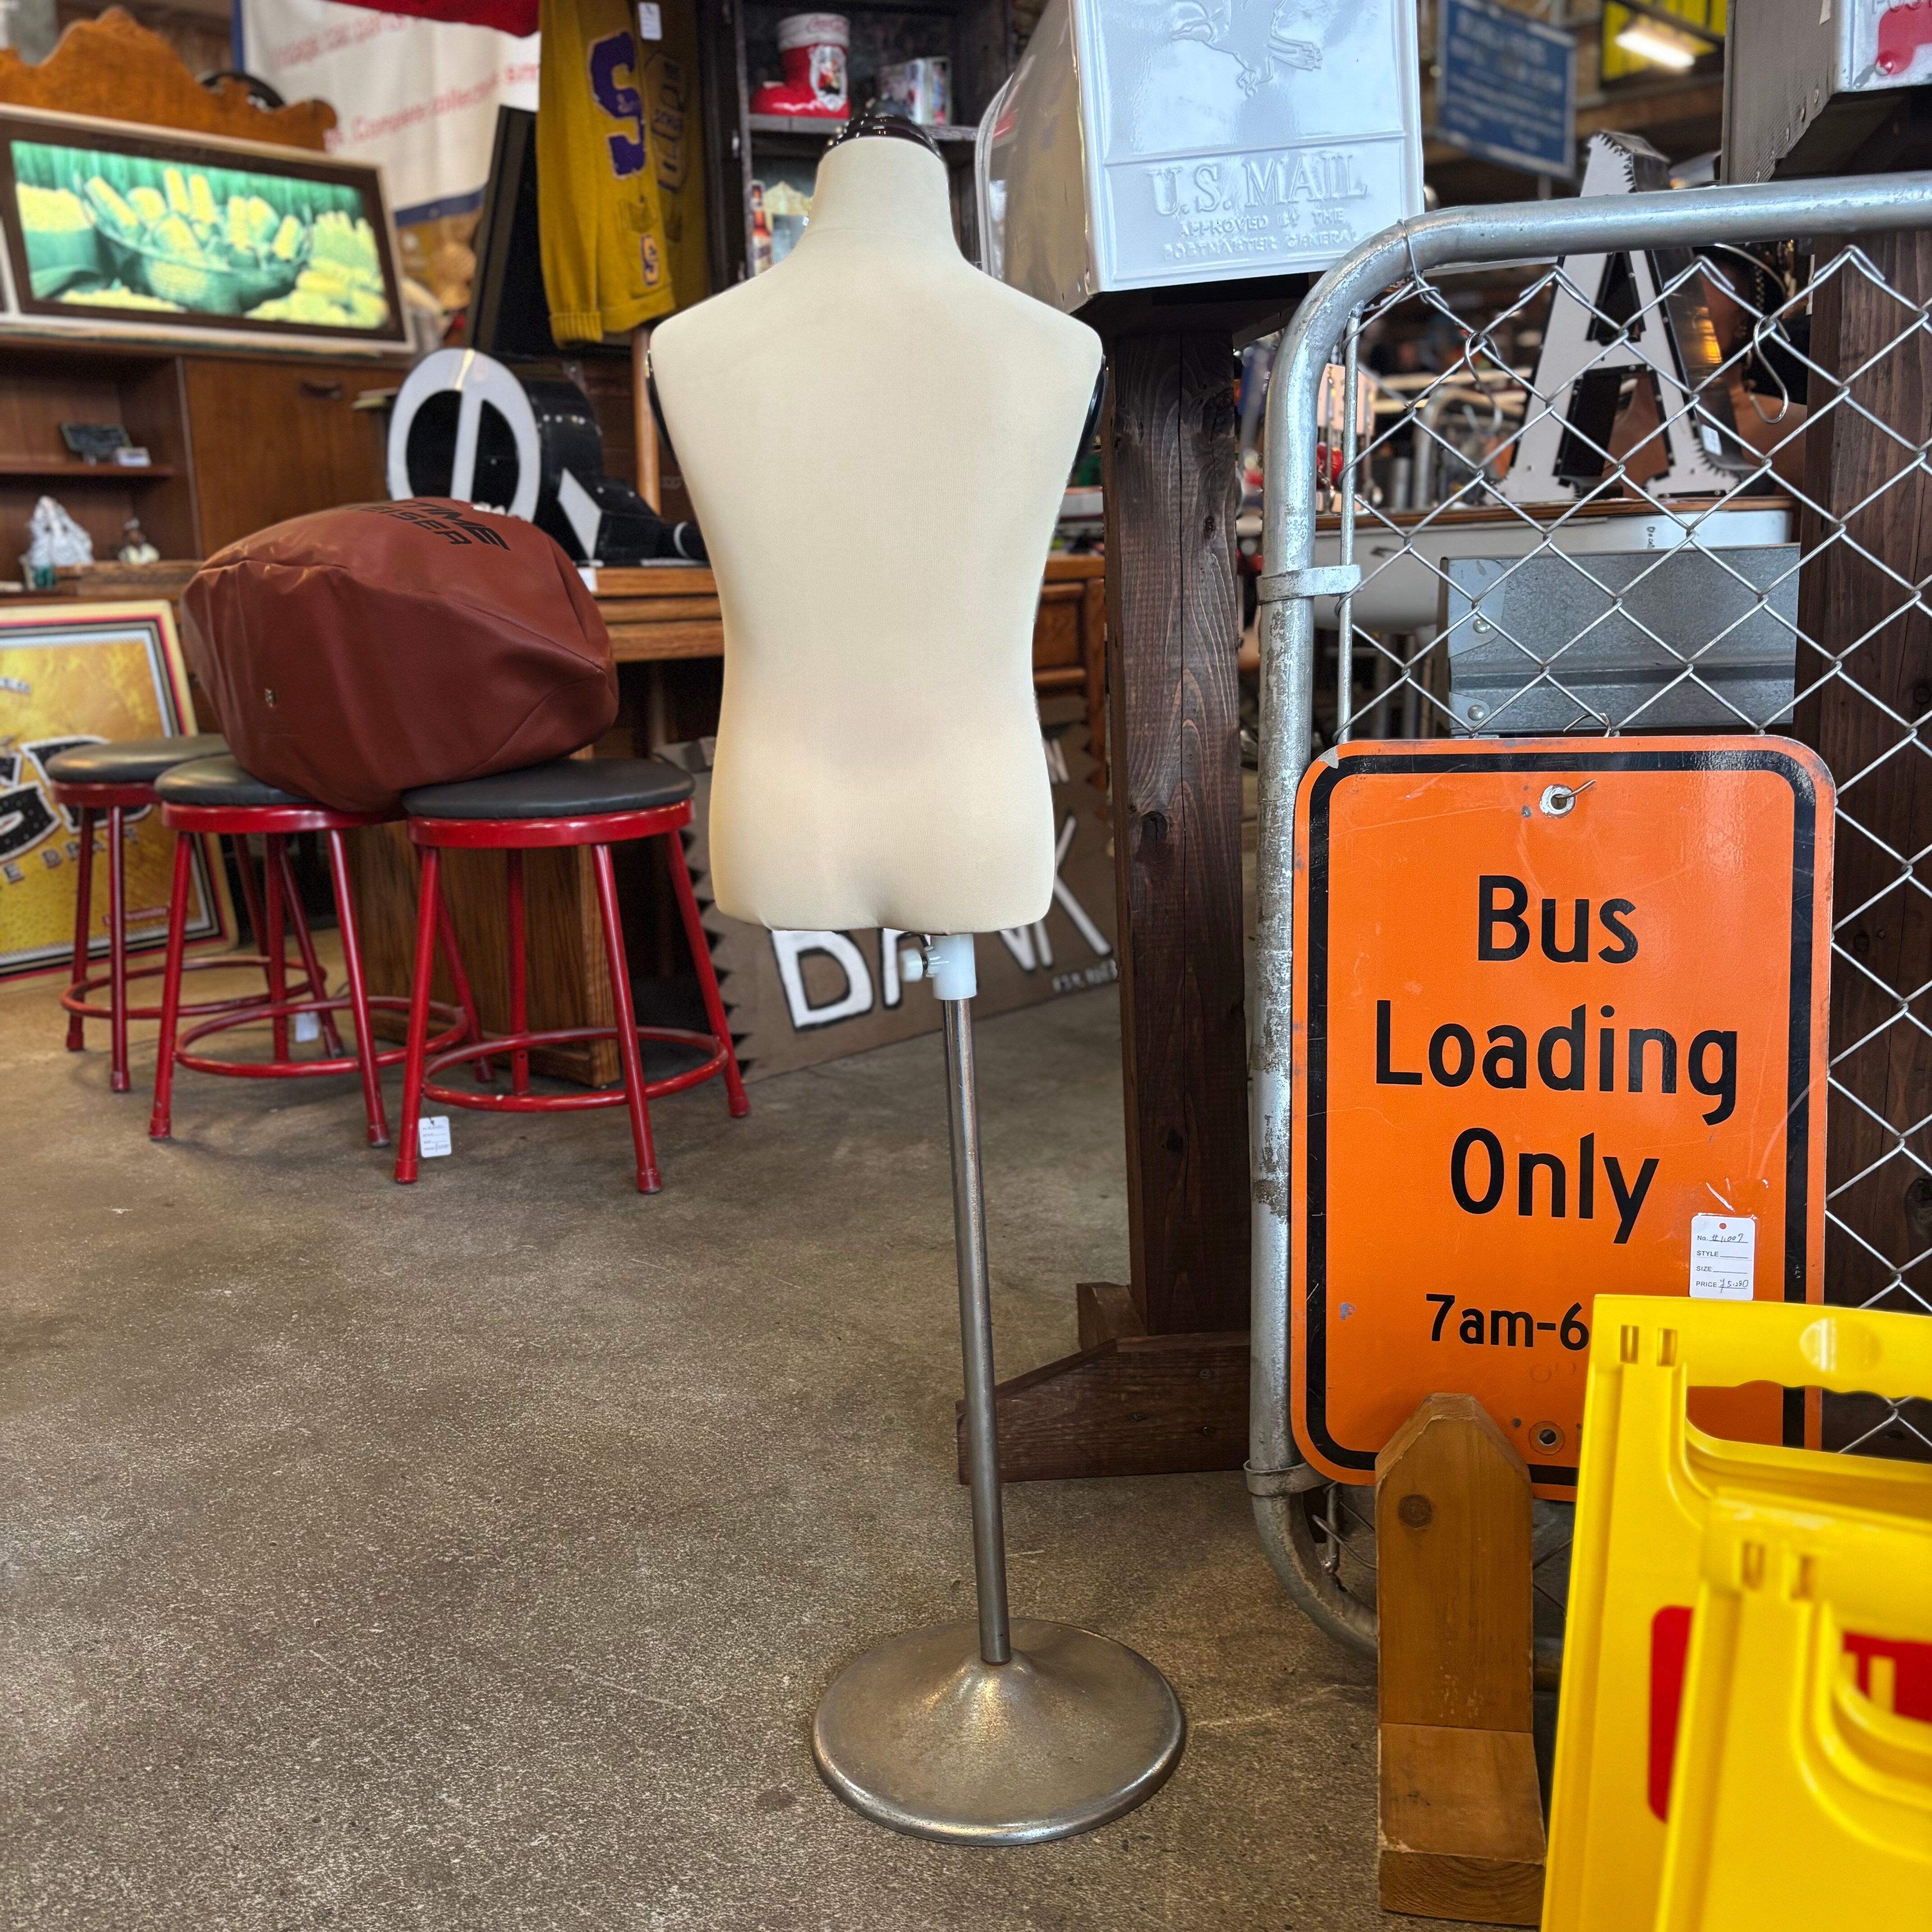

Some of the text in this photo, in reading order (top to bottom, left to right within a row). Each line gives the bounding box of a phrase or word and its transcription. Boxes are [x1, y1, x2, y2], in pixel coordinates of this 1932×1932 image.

[1146, 154, 1372, 216] U.S. MAIL
[1311, 207, 1344, 225] THE
[1477, 874, 1639, 964] Bus
[1375, 999, 1738, 1126] Loading
[1450, 1127, 1660, 1245] Only
[1426, 1293, 1590, 1351] 7am-6
